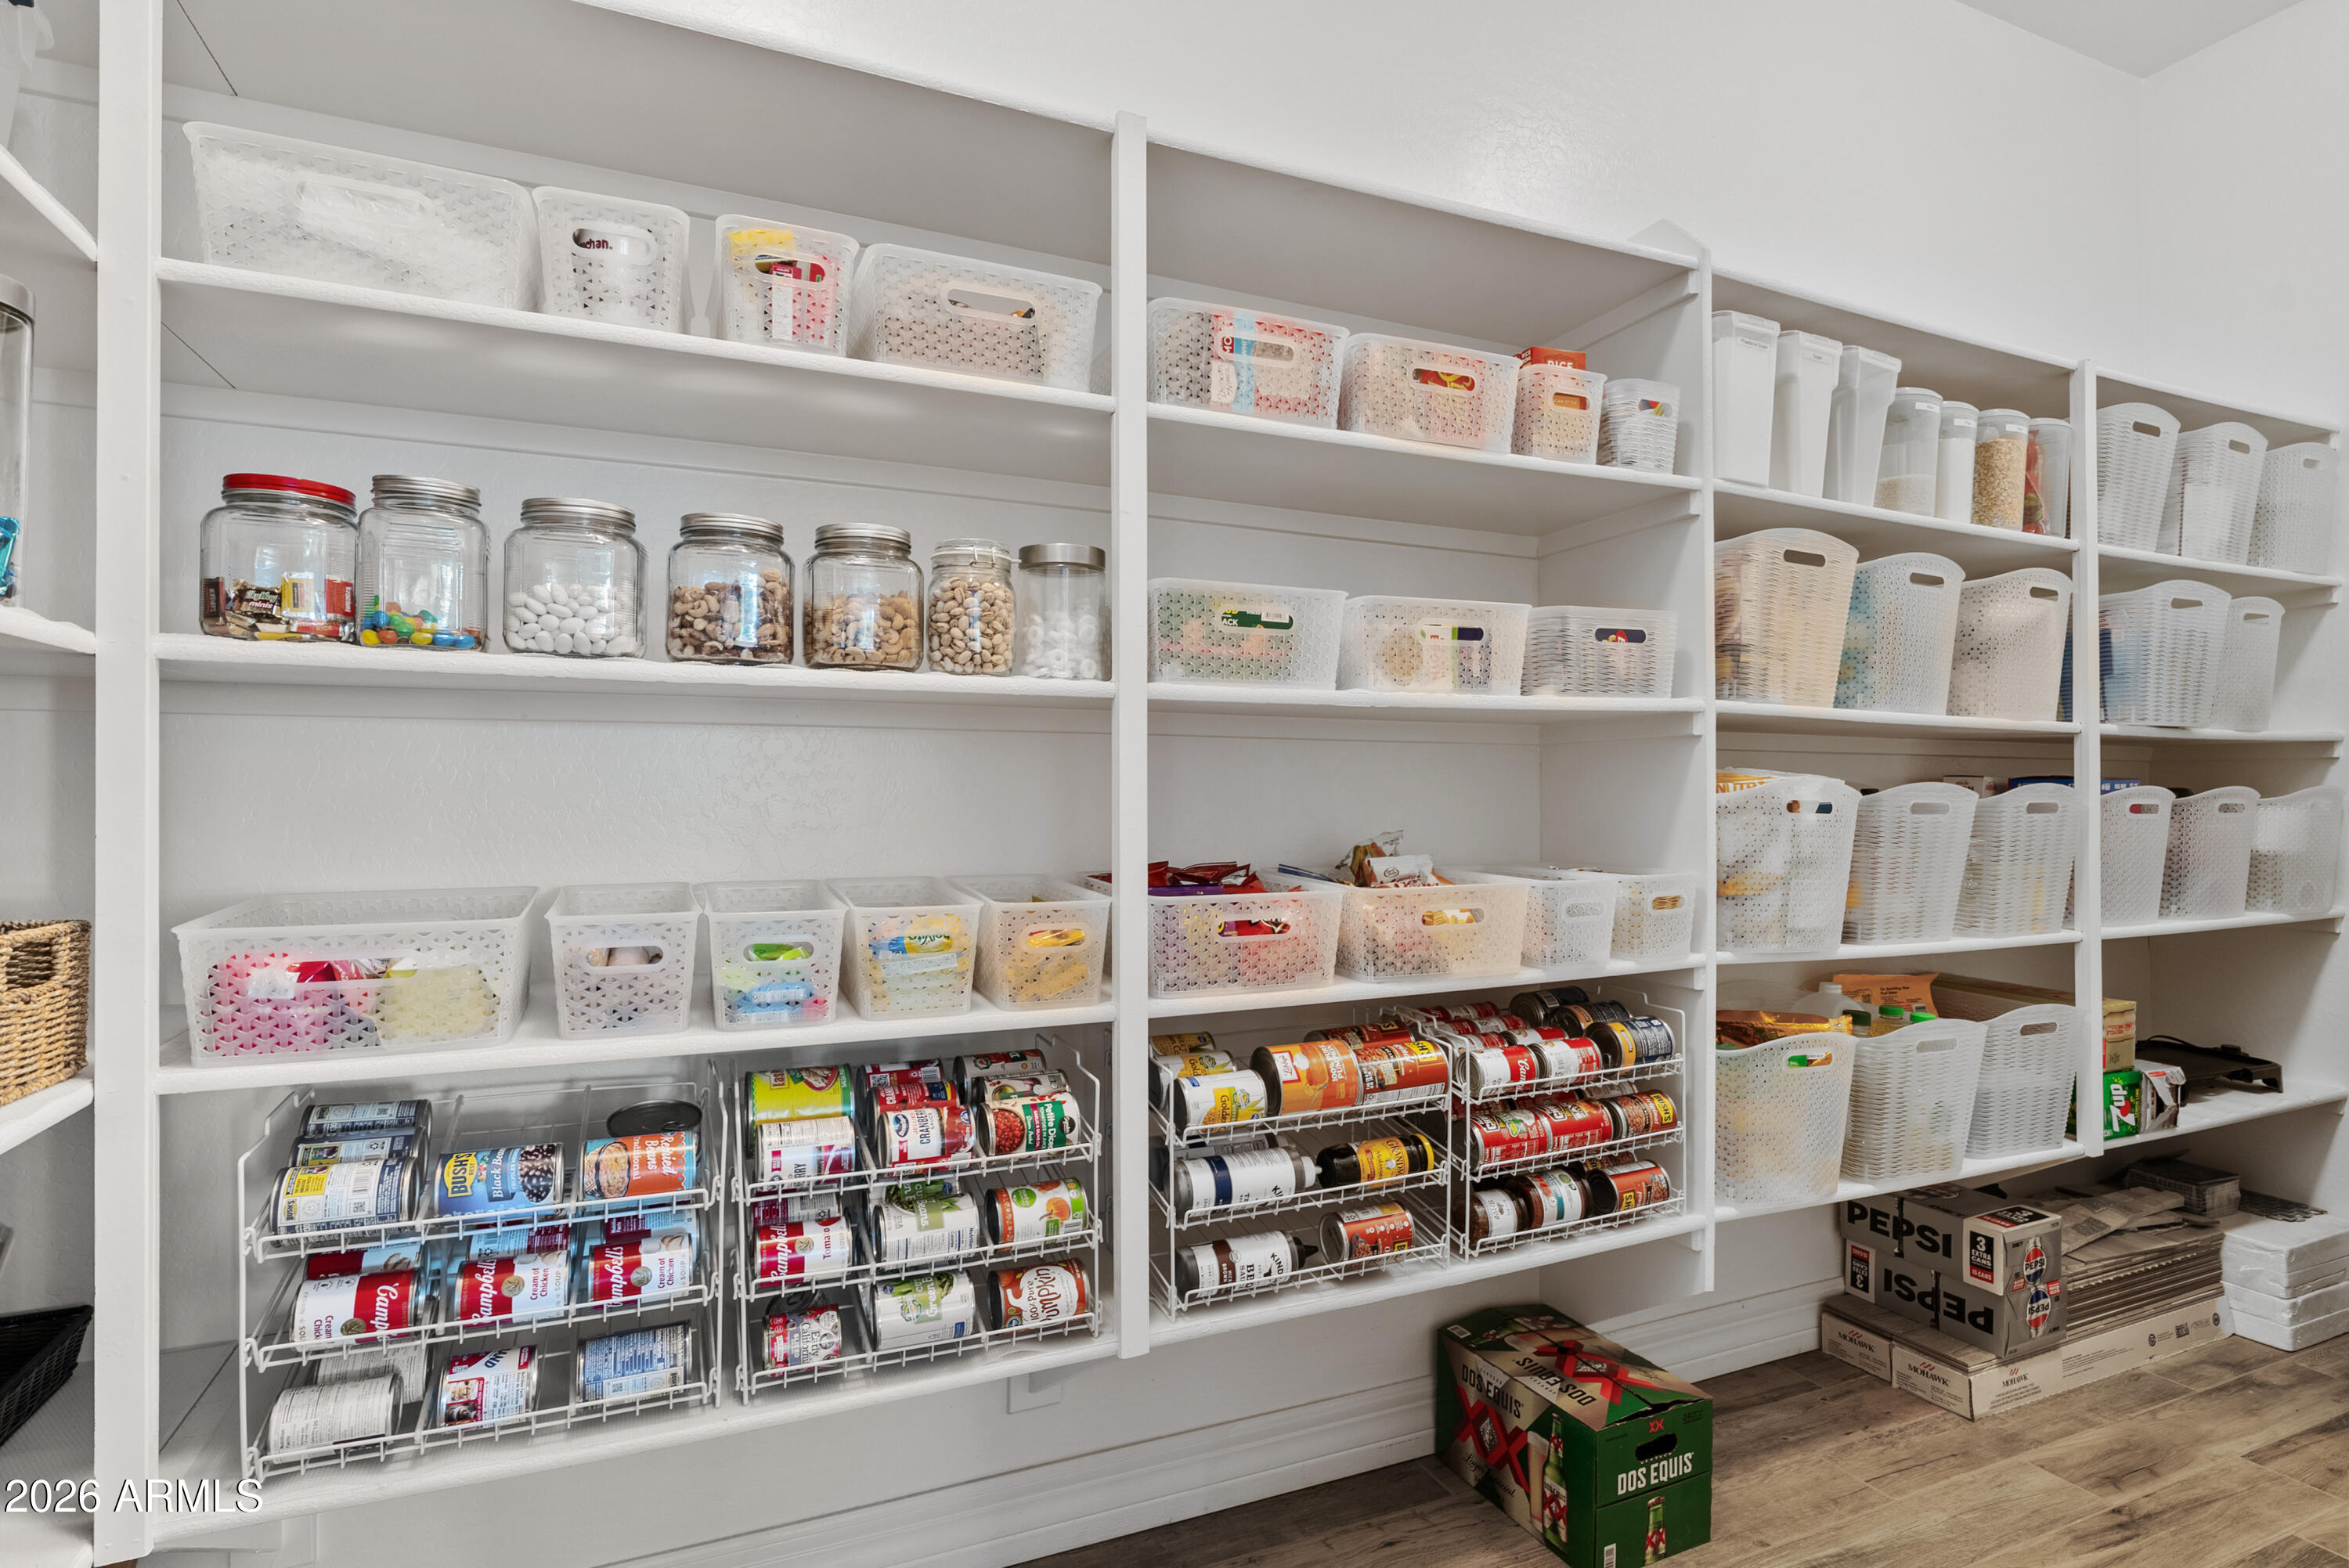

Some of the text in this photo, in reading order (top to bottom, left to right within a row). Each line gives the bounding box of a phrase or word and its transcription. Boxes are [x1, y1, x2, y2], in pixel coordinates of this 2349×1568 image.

[1189, 1058, 1201, 1076] Gold
[1045, 1103, 1055, 1127] Petite
[1221, 1095, 1230, 1123] Golde
[1653, 1094, 1671, 1123] BUSH'S
[2110, 1083, 2135, 1133] 7up
[645, 1140, 659, 1171] Beans
[660, 1136, 678, 1176] Refried
[1386, 1140, 1405, 1176] GRANDM
[451, 1153, 472, 1195] BUSH'S
[491, 1148, 507, 1199] Black Bean
[286, 1200, 295, 1220] BUSH'S
[1847, 1200, 1952, 1259] PEPSI
[1972, 1249, 1991, 1261] EXTRA
[1976, 1237, 1986, 1252] 3
[1972, 1256, 1991, 1267] CANS
[2025, 1258, 2045, 1272] PEPSI
[530, 1277, 539, 1300] Cream
[540, 1268, 549, 1297] Chicken
[1856, 1274, 1864, 1289] 3
[1977, 1271, 1992, 1281] CANS
[926, 1282, 938, 1317] Green
[1884, 1268, 1994, 1335] PEPSI
[2028, 1303, 2049, 1315] PEPSI
[808, 1331, 821, 1357] Early
[1838, 1332, 1875, 1353] MOHAWK
[1516, 1357, 1597, 1407] DOS EQUIS
[1907, 1363, 1950, 1387] MOHAWK
[2002, 1374, 2028, 1387] MOHAWK
[1462, 1364, 1521, 1418] DOS EQUIS
[1618, 1452, 1693, 1496] DOS EQUIS
